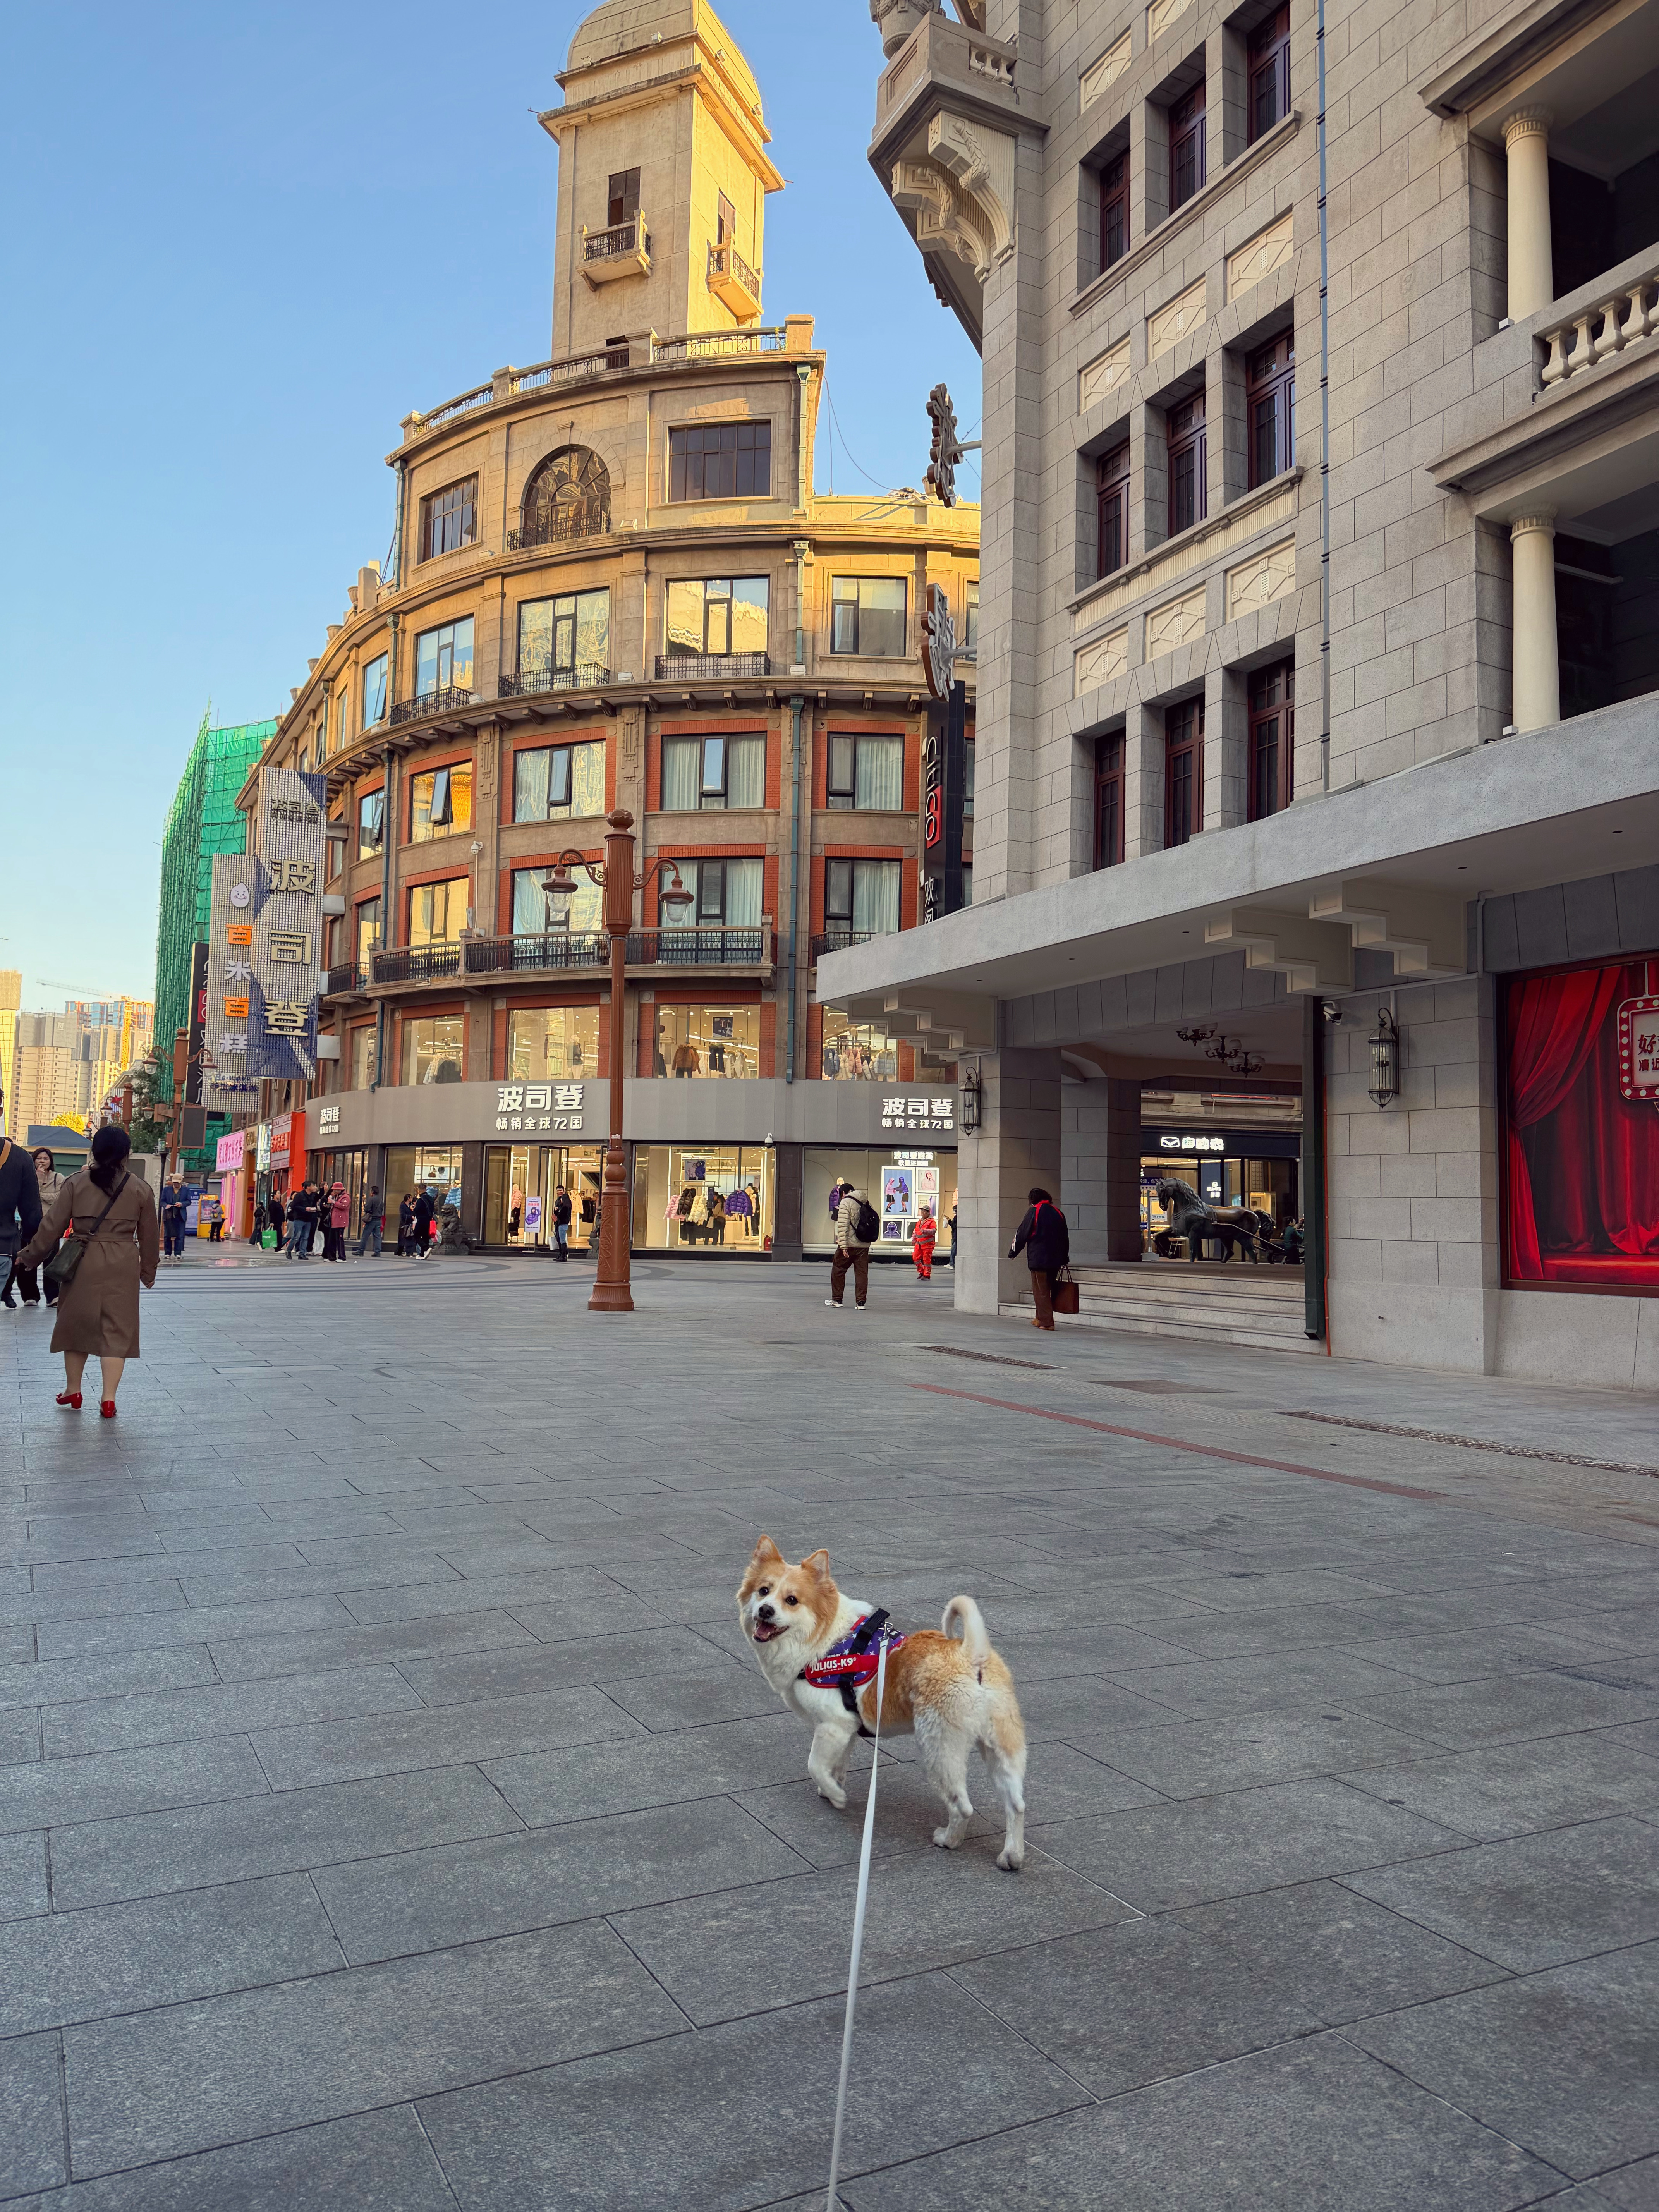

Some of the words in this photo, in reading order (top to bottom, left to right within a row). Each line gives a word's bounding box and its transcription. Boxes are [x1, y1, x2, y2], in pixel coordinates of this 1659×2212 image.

[264, 858, 315, 1036] 波司登
[220, 924, 252, 1054] 百米百糕
[1638, 1034, 1659, 1055] 好
[497, 1085, 583, 1112] 波司登
[883, 1098, 953, 1116] 波司登
[320, 1106, 339, 1124] 波司登
[496, 1116, 582, 1130] 畅销全球72国
[882, 1118, 953, 1129] 畅销全球72国
